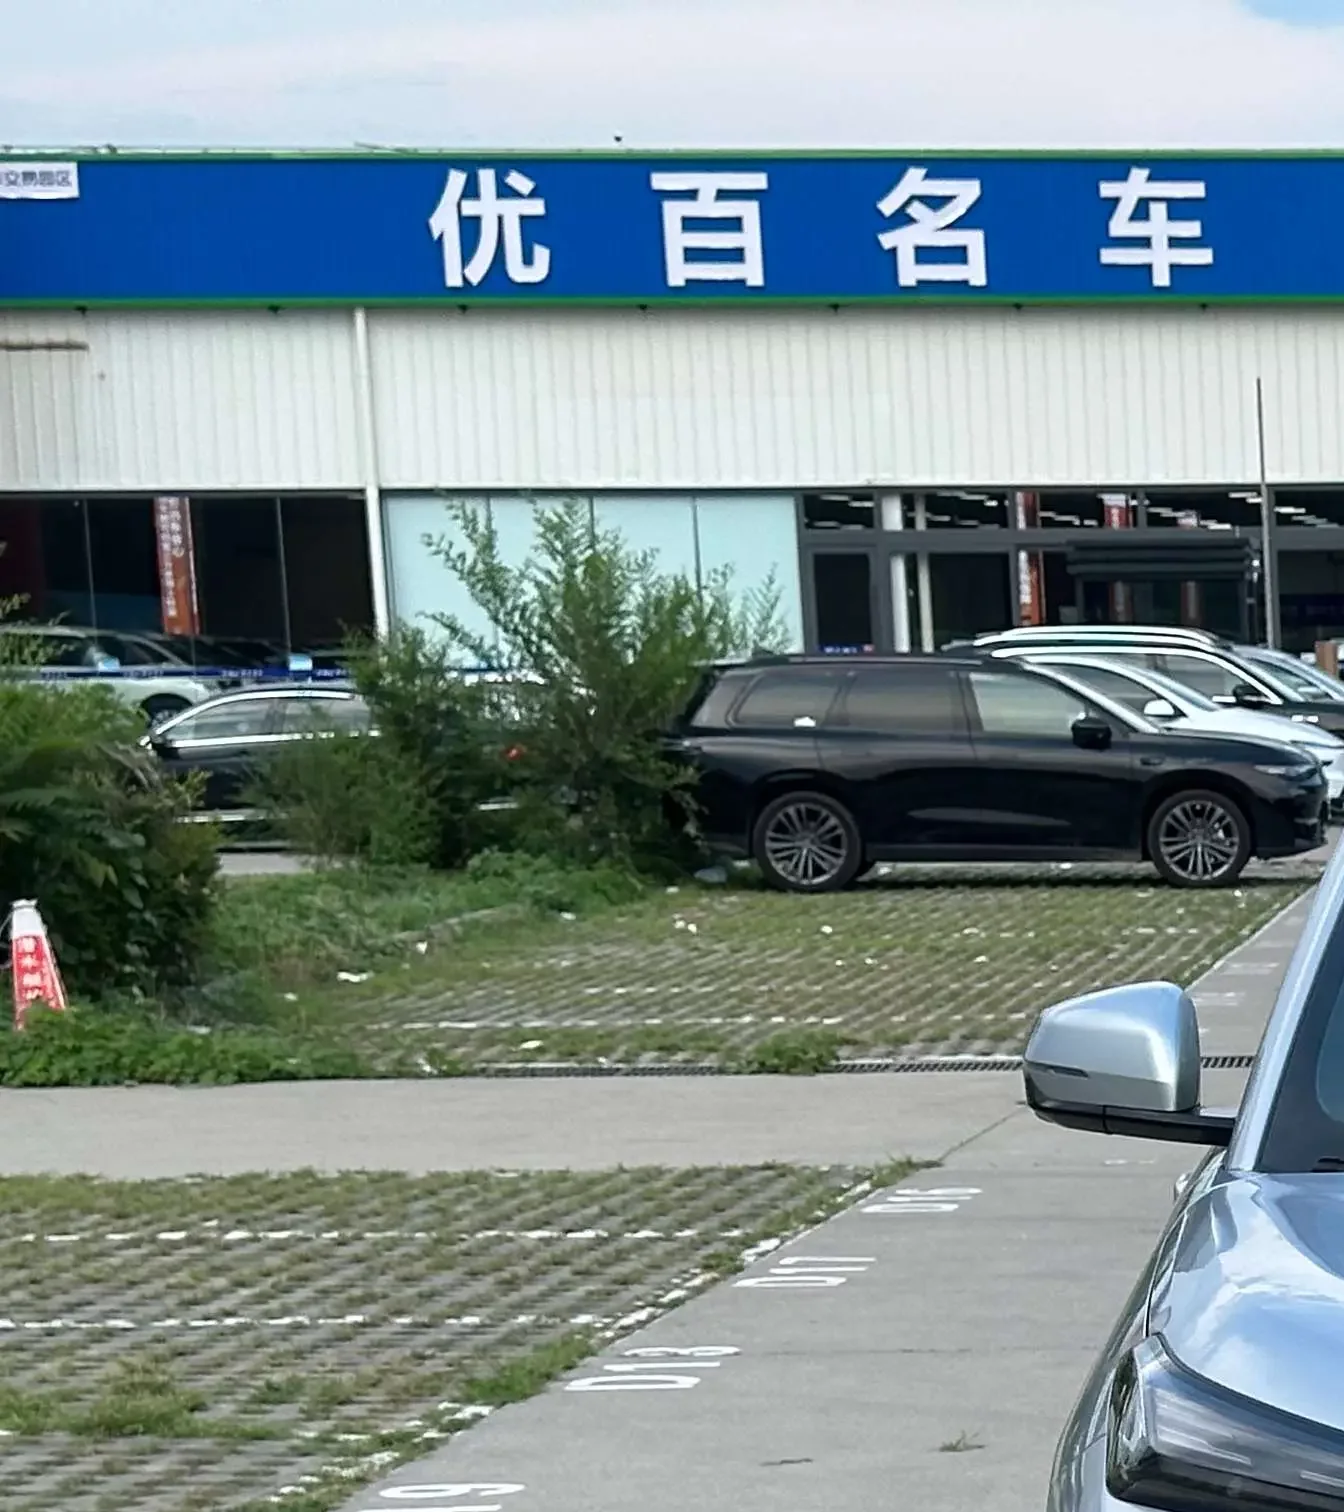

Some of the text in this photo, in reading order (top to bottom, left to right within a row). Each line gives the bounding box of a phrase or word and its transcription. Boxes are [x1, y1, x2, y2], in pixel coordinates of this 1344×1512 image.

[0, 169, 72, 187] 交易园区
[428, 167, 1214, 288] 优百名车
[732, 1255, 877, 1288] D17
